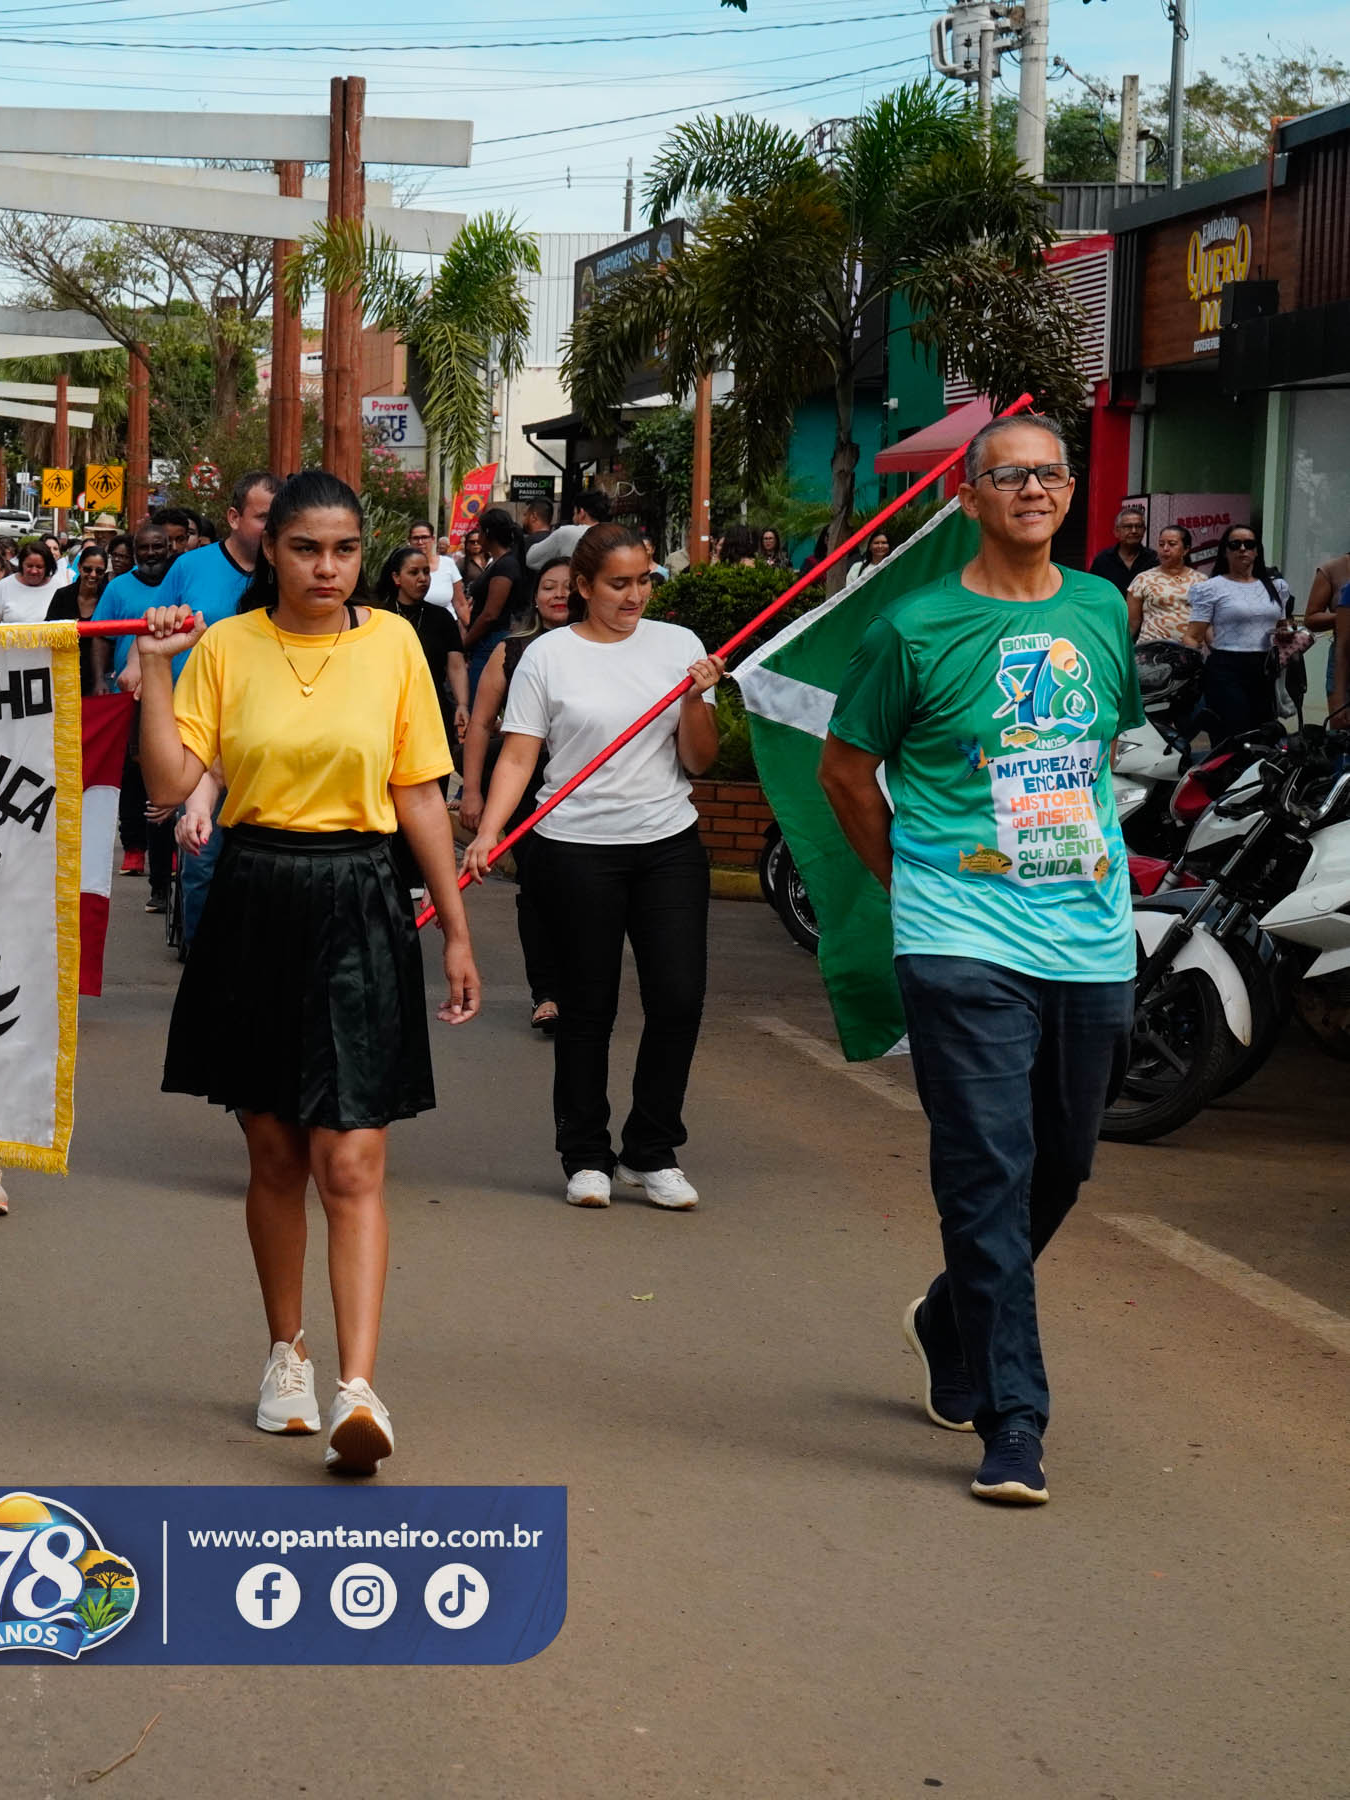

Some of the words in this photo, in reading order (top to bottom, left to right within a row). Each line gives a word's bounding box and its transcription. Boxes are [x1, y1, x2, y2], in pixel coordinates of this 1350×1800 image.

[1177, 512, 1232, 529] BEBIDAS
[1001, 634, 1051, 654] BONITO
[997, 756, 1076, 780] NATUREZA
[1012, 816, 1035, 829] QUE
[1017, 824, 1087, 844] FUTURO
[1018, 850, 1045, 862] QUE
